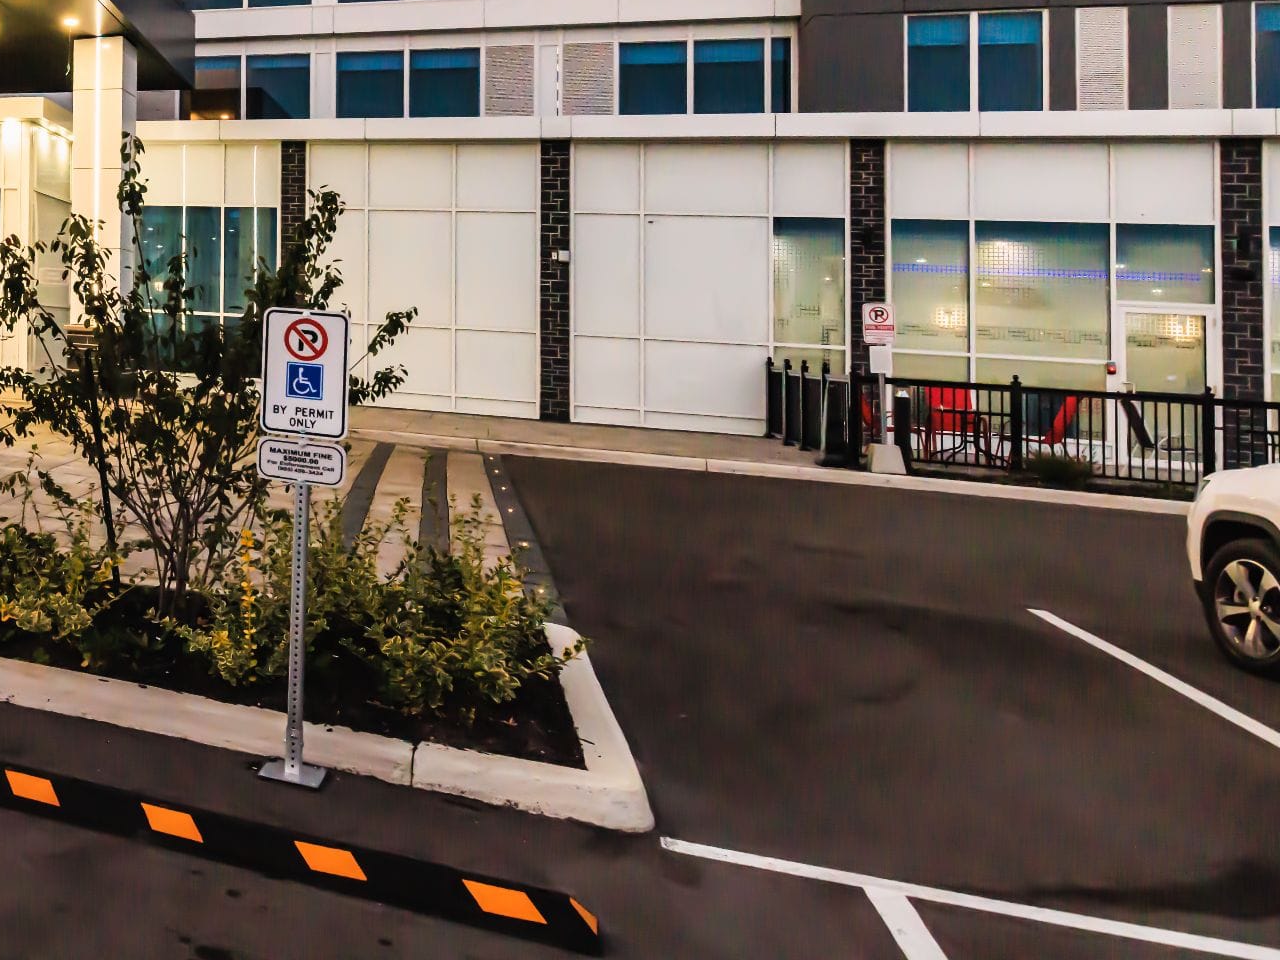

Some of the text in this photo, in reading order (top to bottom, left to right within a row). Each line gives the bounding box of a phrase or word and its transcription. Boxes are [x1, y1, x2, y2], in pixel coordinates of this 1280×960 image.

[273, 404, 335, 420] BY PERMIT
[289, 417, 317, 429] ONLY
[269, 446, 333, 461] MAXIMUM FINE
